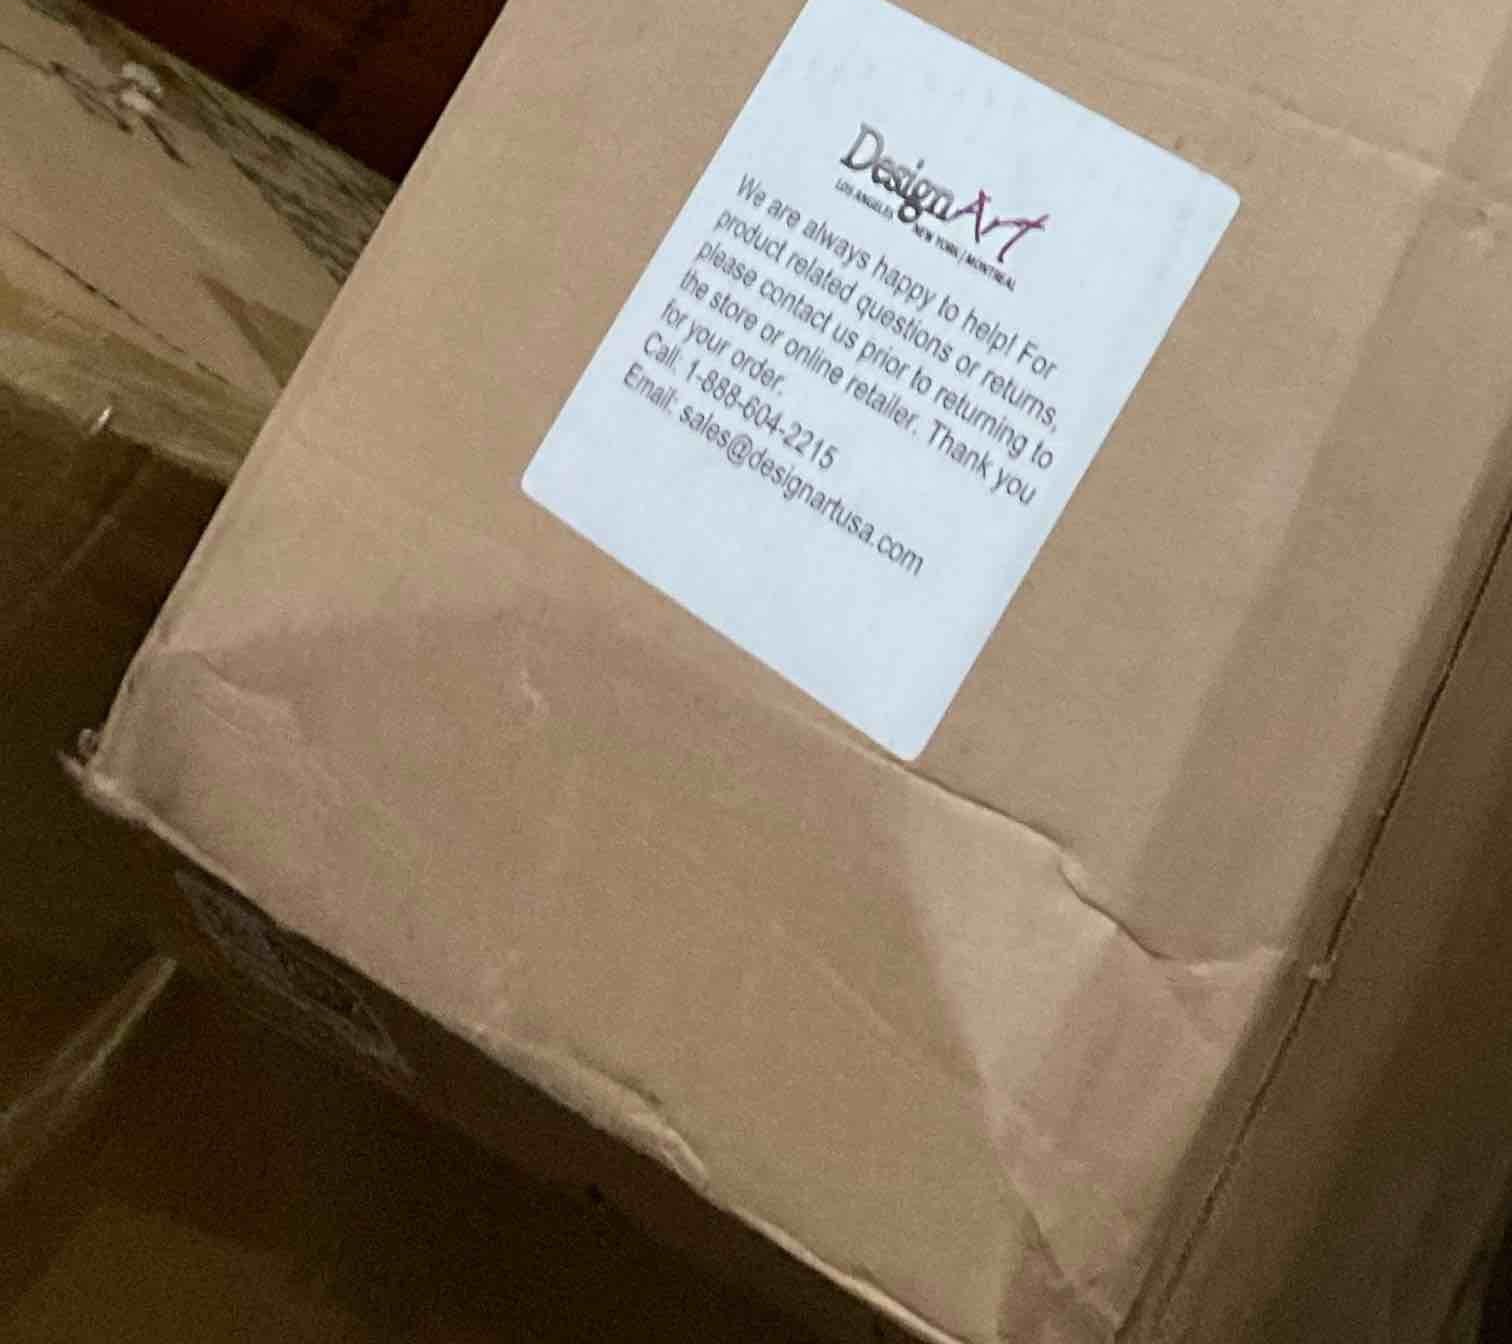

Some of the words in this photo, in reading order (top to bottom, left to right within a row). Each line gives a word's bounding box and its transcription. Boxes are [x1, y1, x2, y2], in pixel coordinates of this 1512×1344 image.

[660, 297, 688, 331] for
[681, 318, 731, 358] your
[730, 347, 785, 397] order.
[695, 240, 758, 289] please
[759, 278, 833, 335] contact
[832, 321, 860, 351] us
[857, 339, 911, 382] prior
[909, 365, 933, 396] to
[933, 384, 1029, 461] returning
[1031, 439, 1054, 471] to
[713, 208, 788, 263] product
[785, 250, 858, 304] related
[856, 293, 954, 364] questions
[954, 353, 981, 379] or
[979, 366, 1058, 434] returns,
[737, 172, 766, 208] We
[767, 198, 801, 229] are
[802, 220, 872, 271] always
[871, 255, 937, 313] happy
[938, 294, 960, 322] to
[961, 308, 1019, 358] help!
[1016, 340, 1058, 381] For
[622, 361, 679, 416] Email:
[679, 404, 925, 577] sales@designartusa.com
[642, 330, 683, 376] Call:
[685, 358, 839, 471] 1-888-604-2215
[679, 267, 710, 302] the
[709, 290, 759, 332] store
[759, 322, 785, 347] or
[783, 334, 844, 386] online
[844, 374, 921, 437] retailer.
[927, 417, 994, 480] Thank
[989, 466, 1038, 506] you
